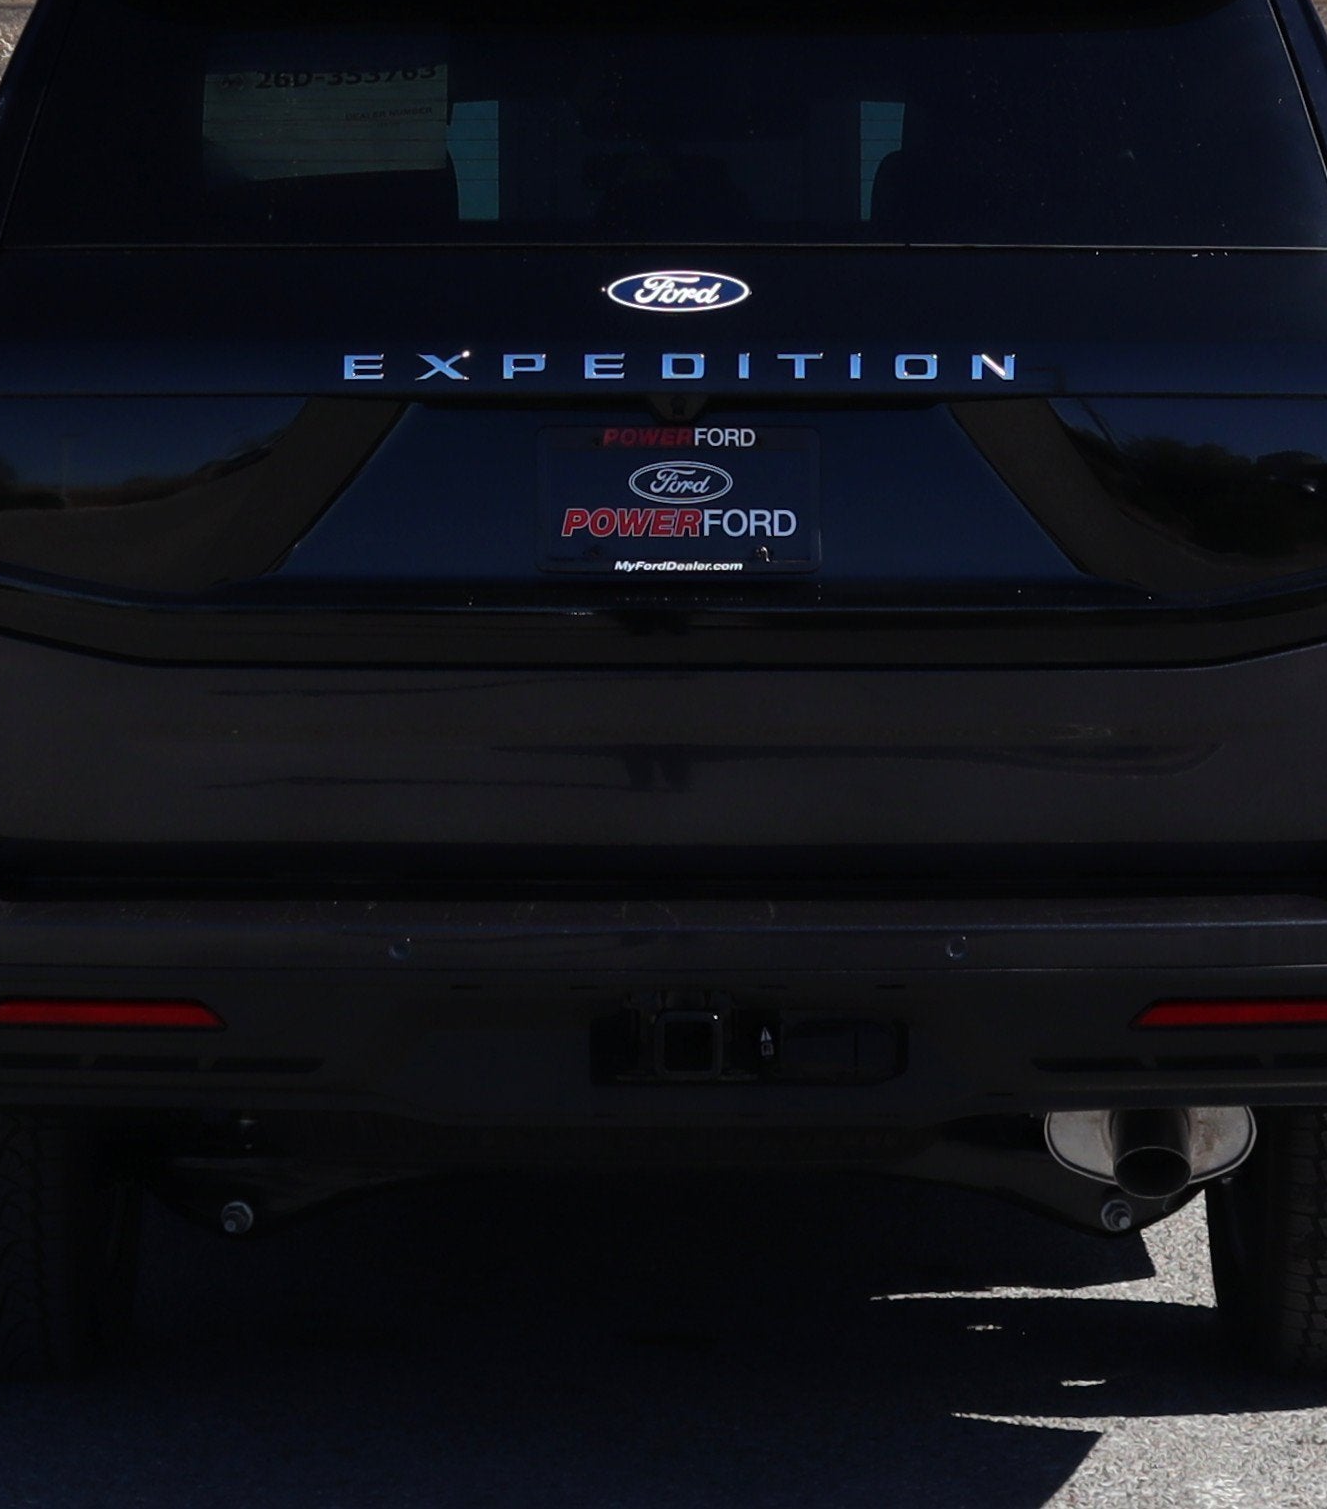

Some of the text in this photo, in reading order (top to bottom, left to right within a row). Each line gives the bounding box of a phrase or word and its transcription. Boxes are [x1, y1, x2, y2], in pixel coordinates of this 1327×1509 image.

[634, 276, 721, 306] Ford
[343, 351, 1015, 380] EXPEDITION
[602, 428, 756, 447] POWERFORD
[650, 467, 711, 494] Ford
[561, 508, 797, 537] POWERFORD
[614, 560, 744, 573] MyFordDealer.com
